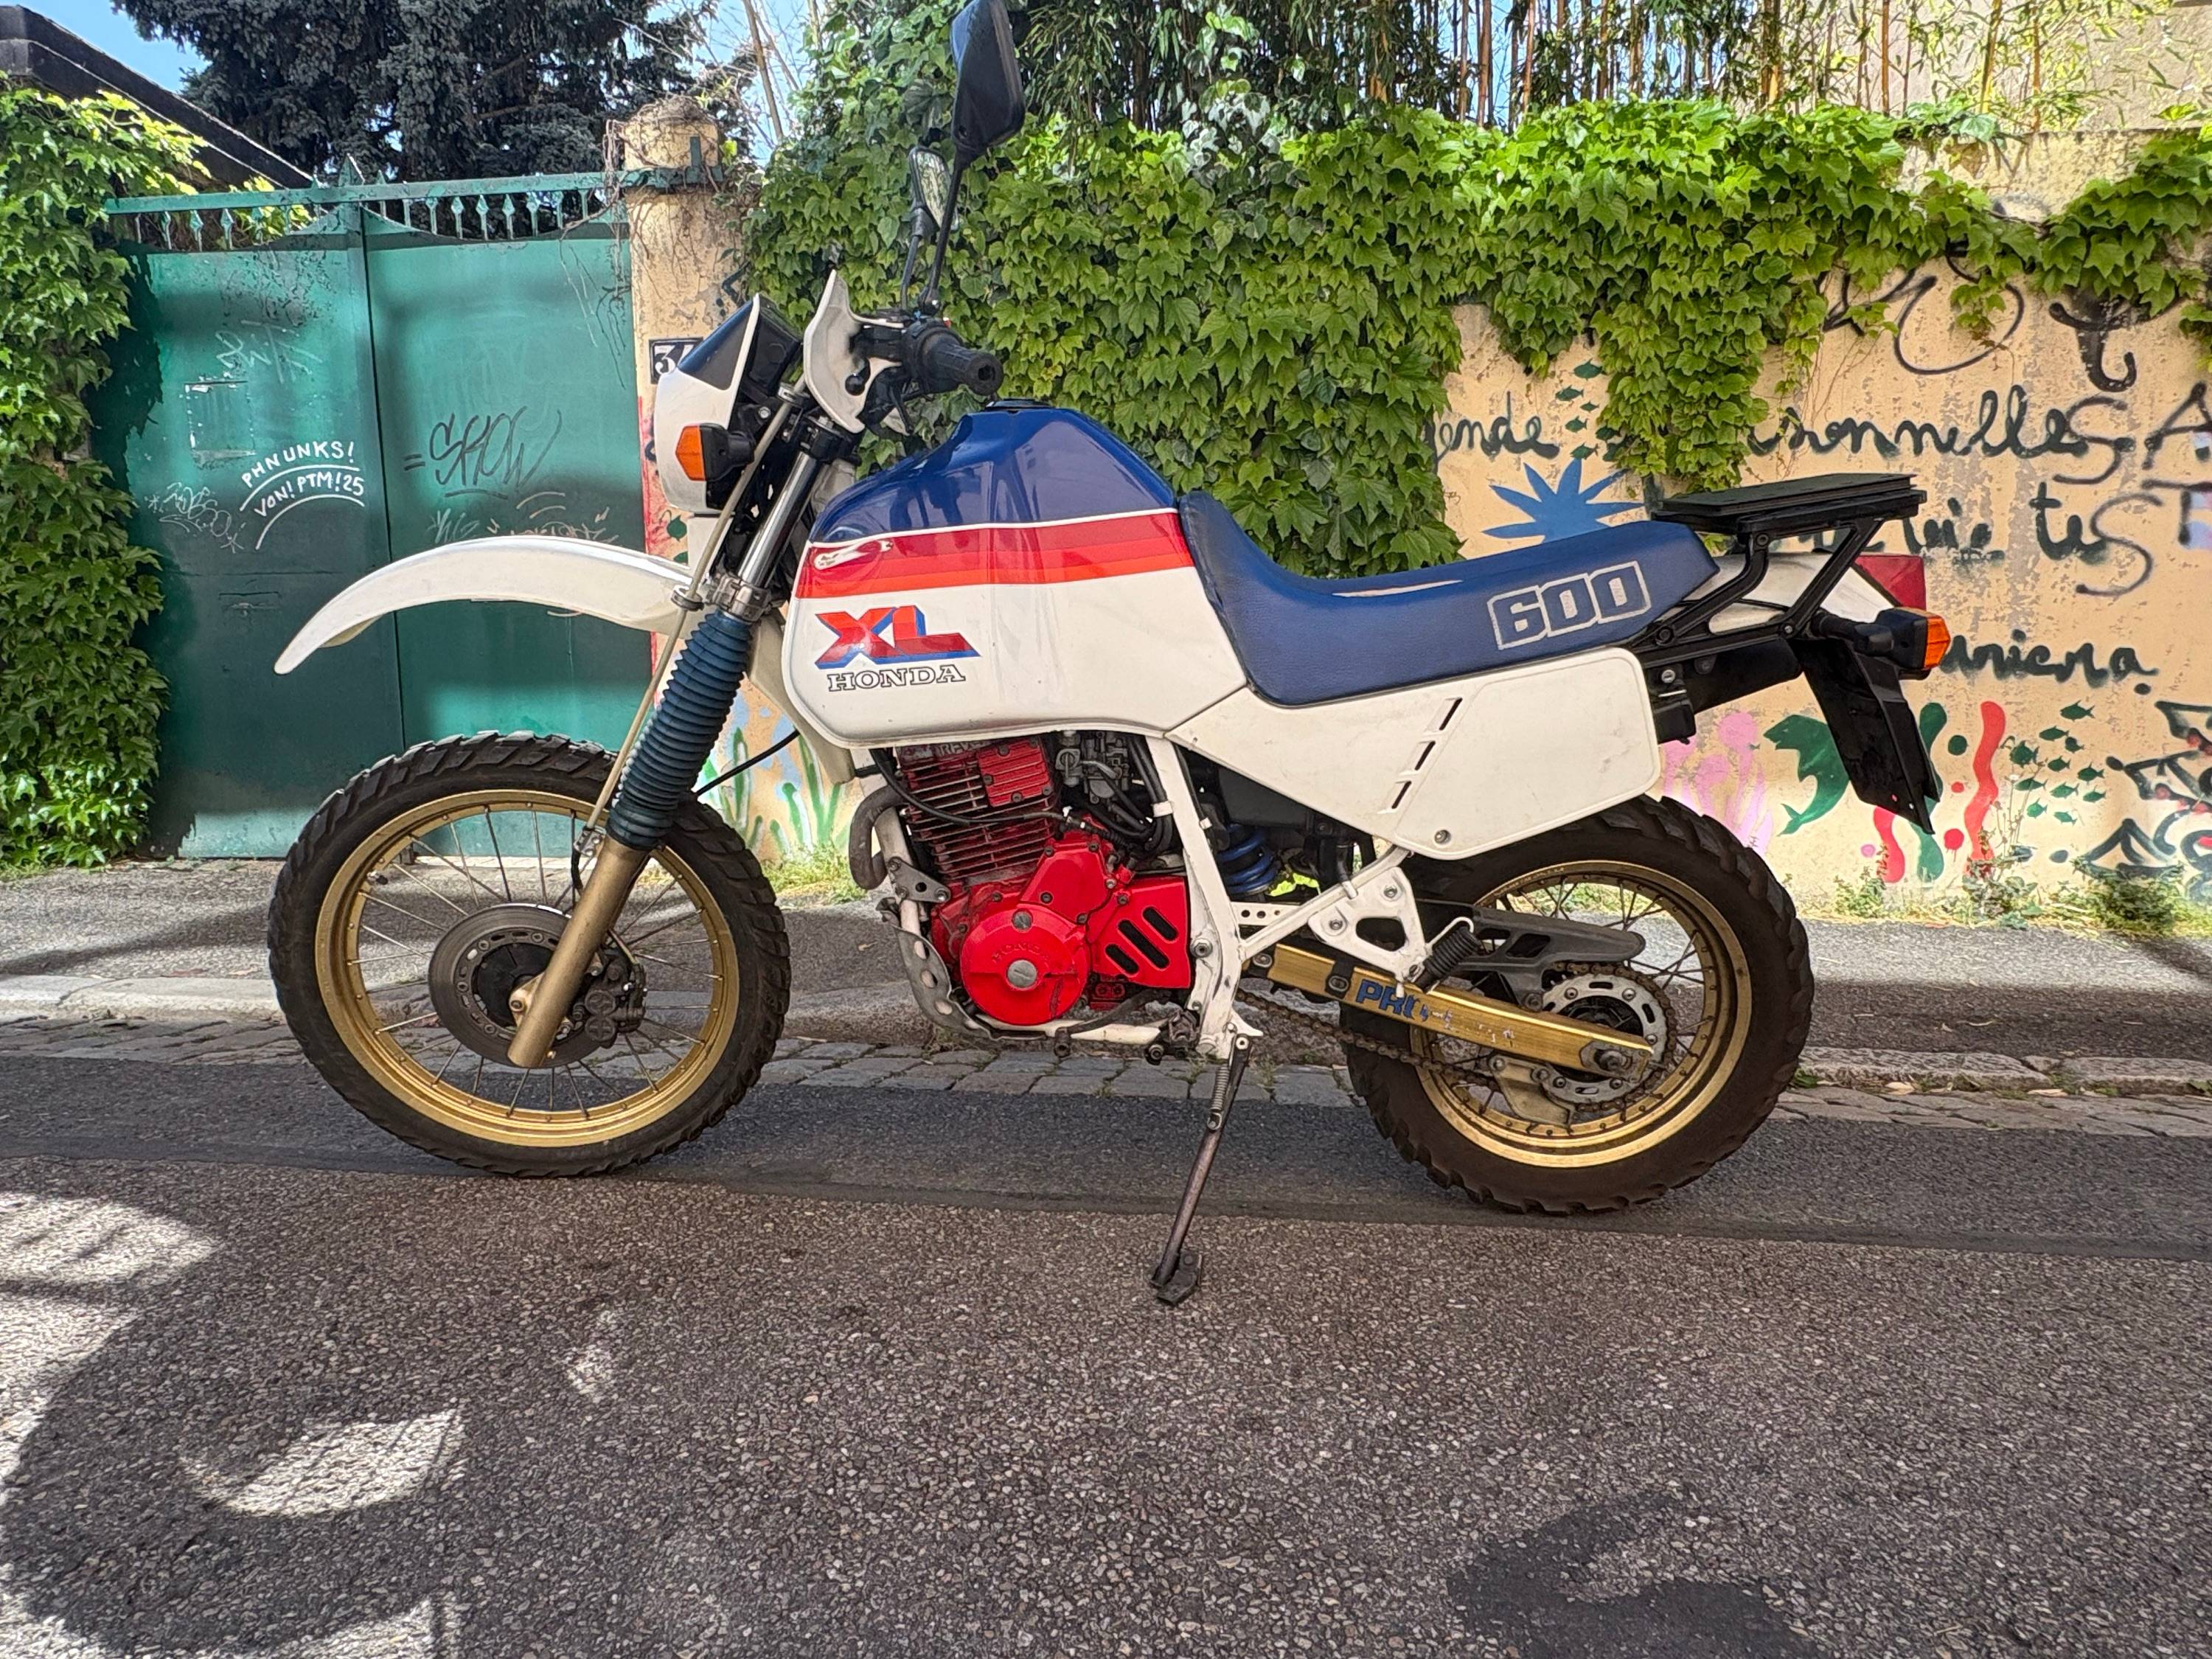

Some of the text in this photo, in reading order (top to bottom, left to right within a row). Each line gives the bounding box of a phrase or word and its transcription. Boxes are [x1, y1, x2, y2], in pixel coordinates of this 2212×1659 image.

[814, 605, 981, 669] XL
[1486, 560, 1652, 651] 600
[826, 664, 966, 692] HONDA
